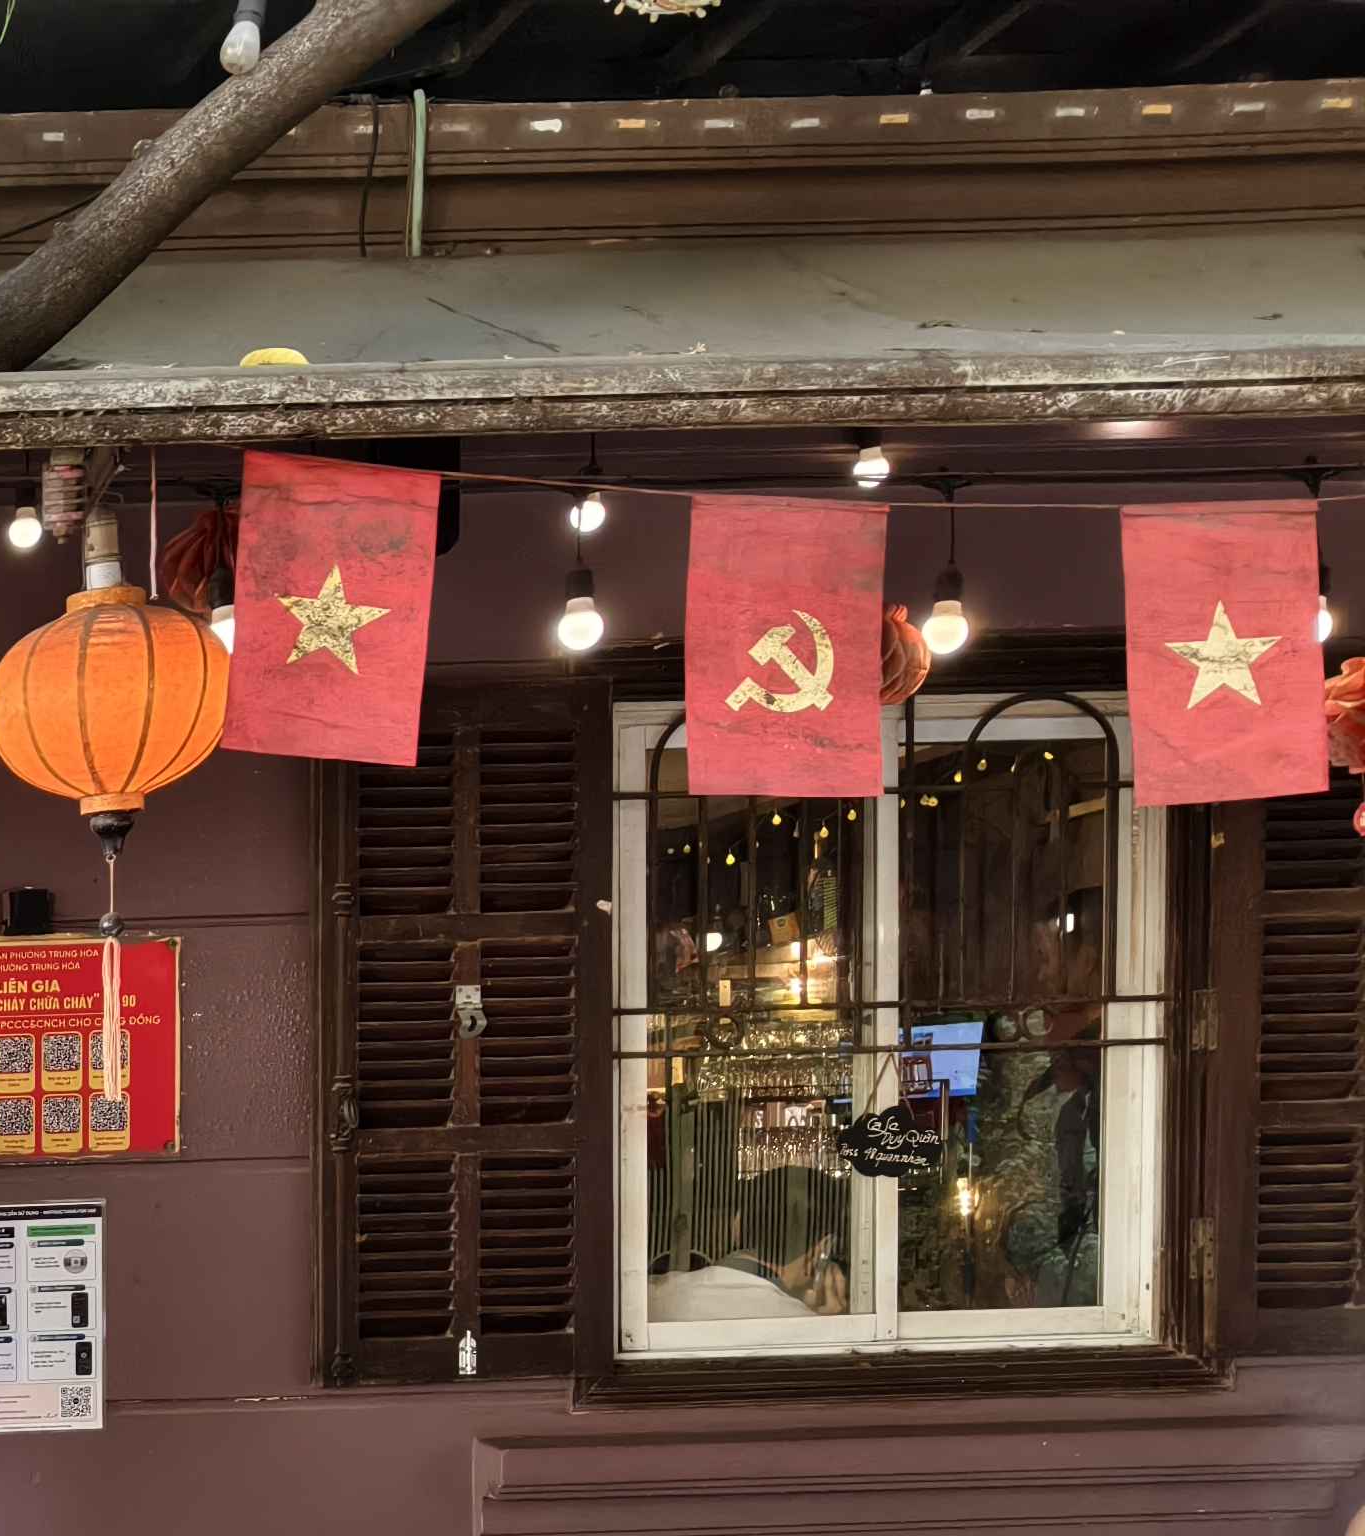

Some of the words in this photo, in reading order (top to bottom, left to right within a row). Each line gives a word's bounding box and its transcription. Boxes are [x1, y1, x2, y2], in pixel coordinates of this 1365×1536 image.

[48, 949, 78, 958] TRUNG
[31, 961, 60, 971] TRUNG
[31, 979, 61, 993] GIA
[68, 1017, 92, 1028] CHO
